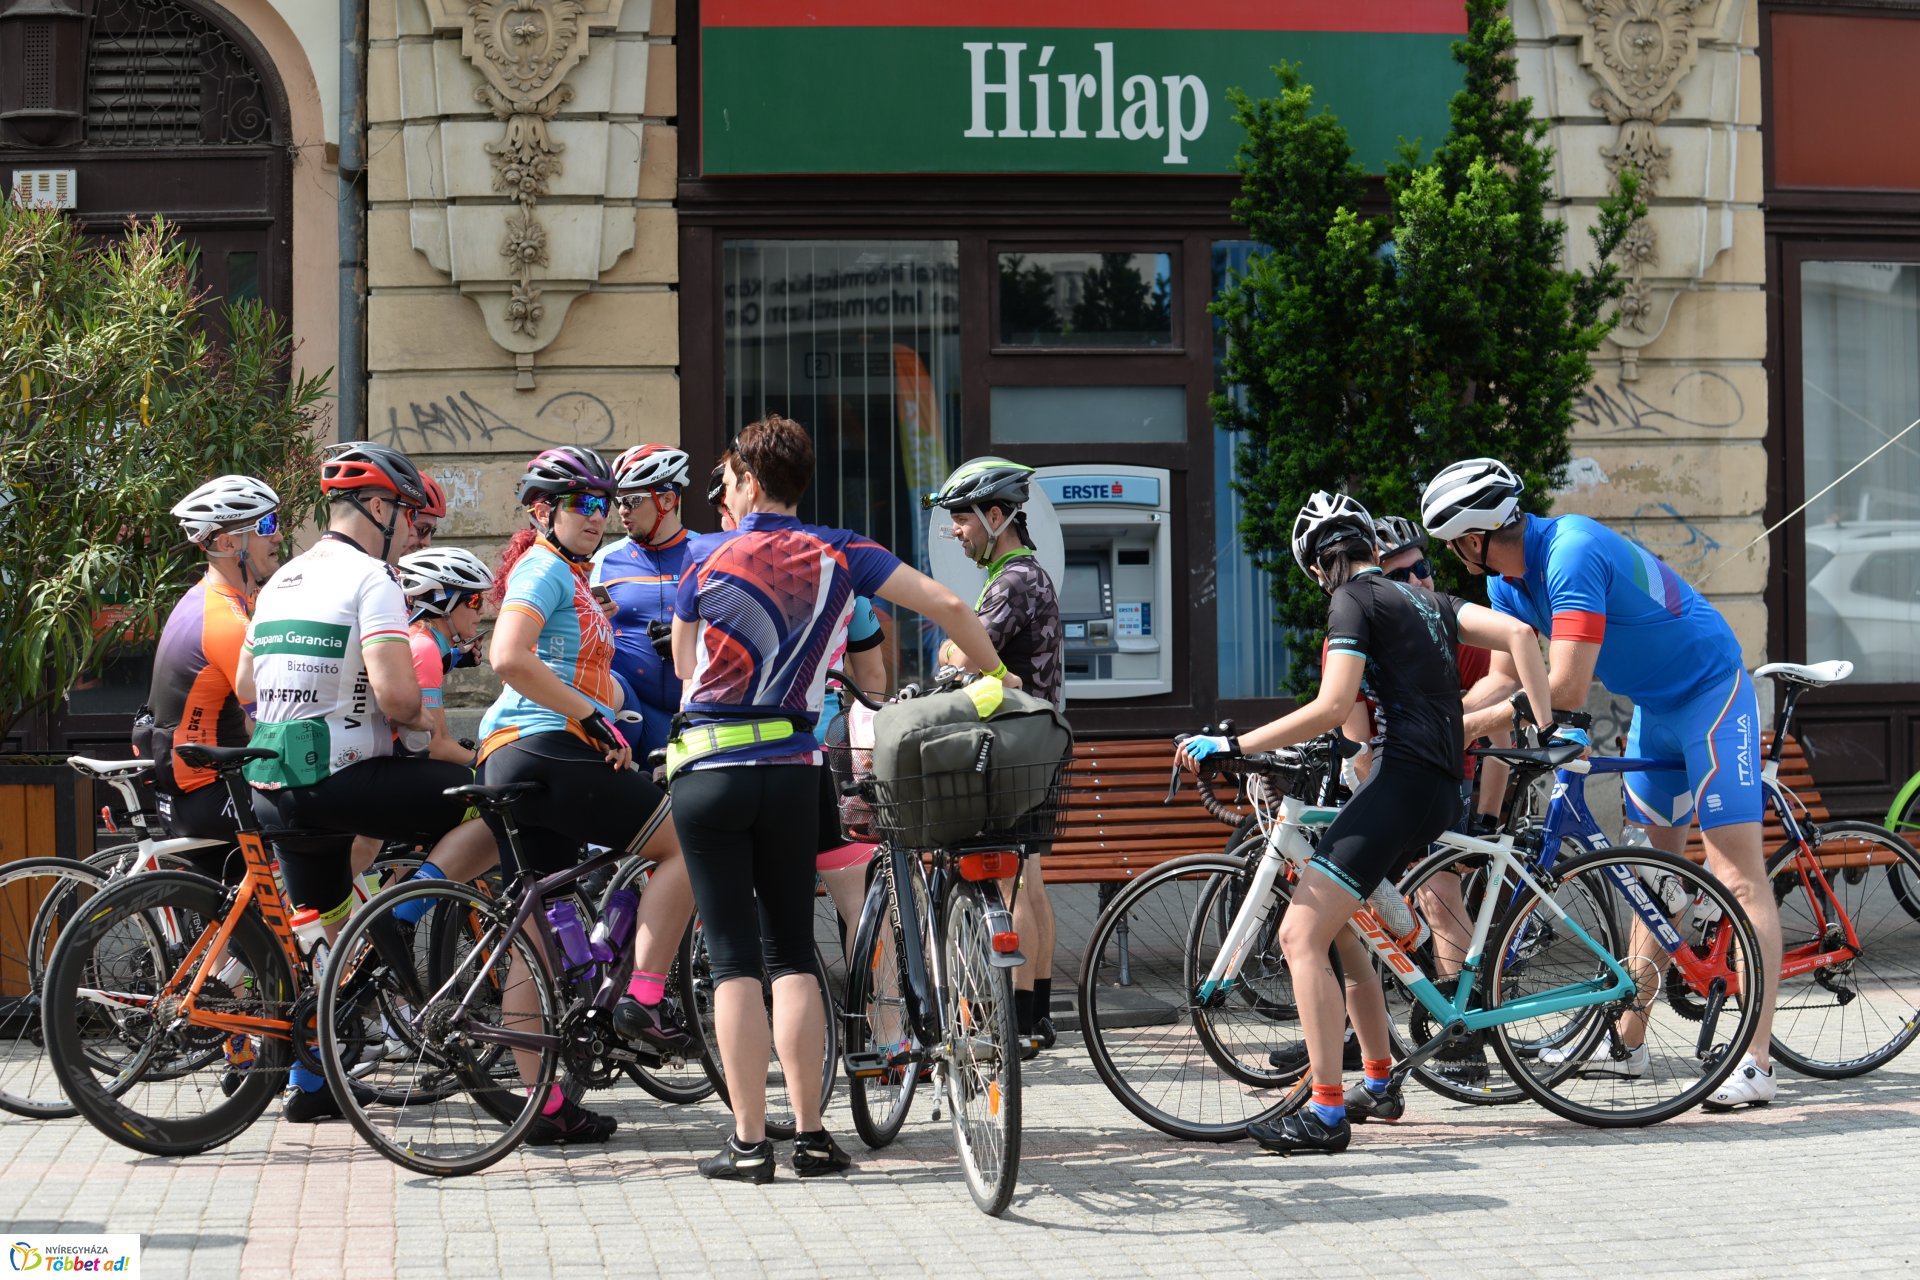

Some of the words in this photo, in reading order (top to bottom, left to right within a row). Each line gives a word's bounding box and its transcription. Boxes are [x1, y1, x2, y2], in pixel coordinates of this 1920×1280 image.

[963, 41, 1209, 164] Hírlap
[402, 482, 422, 498] RUDY
[970, 484, 996, 500] RUDY
[1062, 484, 1109, 499] ERSTE
[213, 512, 245, 521] RUDY
[438, 575, 468, 585] RUDY
[285, 631, 343, 648] Garancia
[287, 660, 339, 675] Biztosító
[1737, 713, 1751, 786] ITALIA
[1313, 854, 1362, 888] LAPIERRE
[1351, 910, 1415, 974] erre
